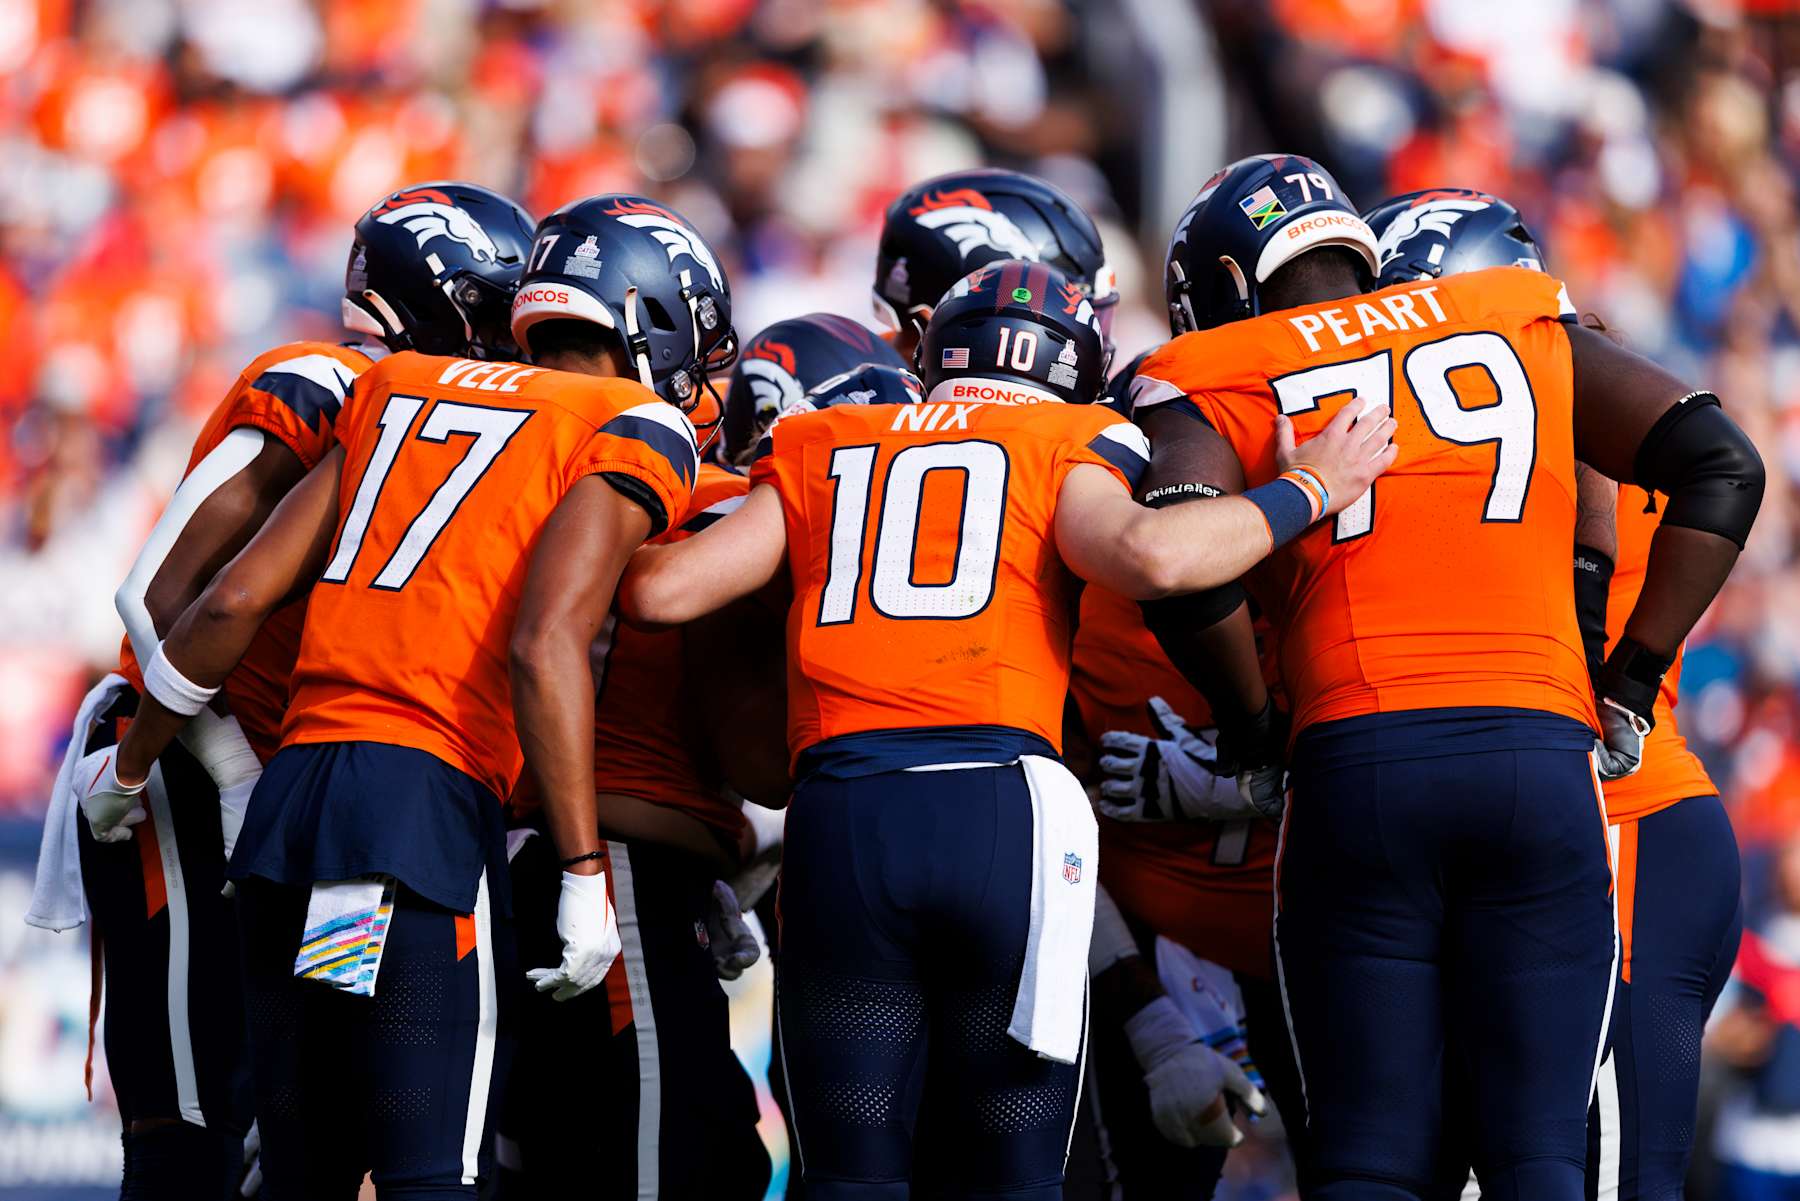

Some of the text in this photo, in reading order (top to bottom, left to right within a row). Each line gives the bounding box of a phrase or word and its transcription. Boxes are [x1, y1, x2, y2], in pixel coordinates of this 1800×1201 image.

[1283, 173, 1333, 203] 79
[526, 234, 560, 273] 17
[512, 290, 569, 312] RONCOS
[1289, 286, 1449, 352] PEART
[996, 326, 1037, 372] 10
[437, 359, 538, 392] VELE
[953, 385, 1050, 405] BRONCO
[890, 403, 983, 431] NIX
[1267, 331, 1538, 546] 79
[320, 393, 537, 592] 17
[816, 439, 1010, 627] 10
